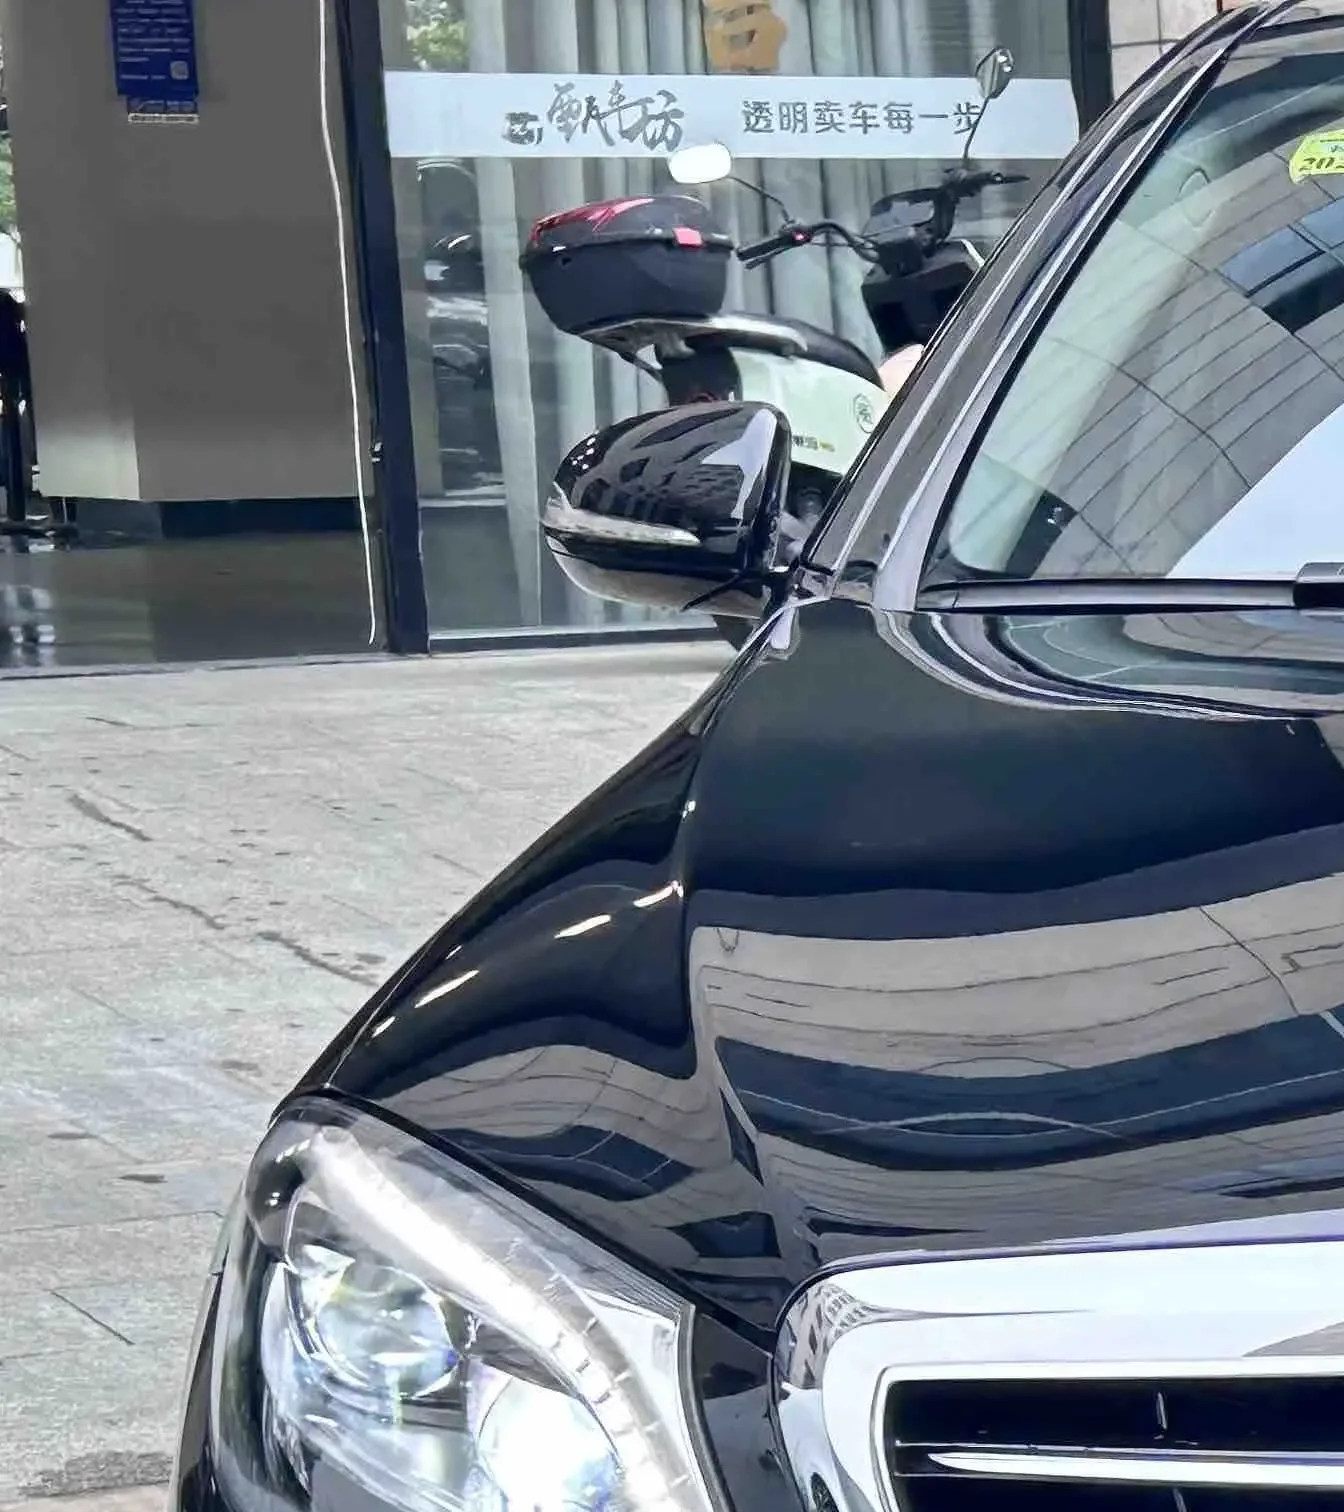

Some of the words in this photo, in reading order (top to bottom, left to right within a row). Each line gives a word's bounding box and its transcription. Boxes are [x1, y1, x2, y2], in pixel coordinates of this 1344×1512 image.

[741, 100, 982, 134] 透明卖车每一步
